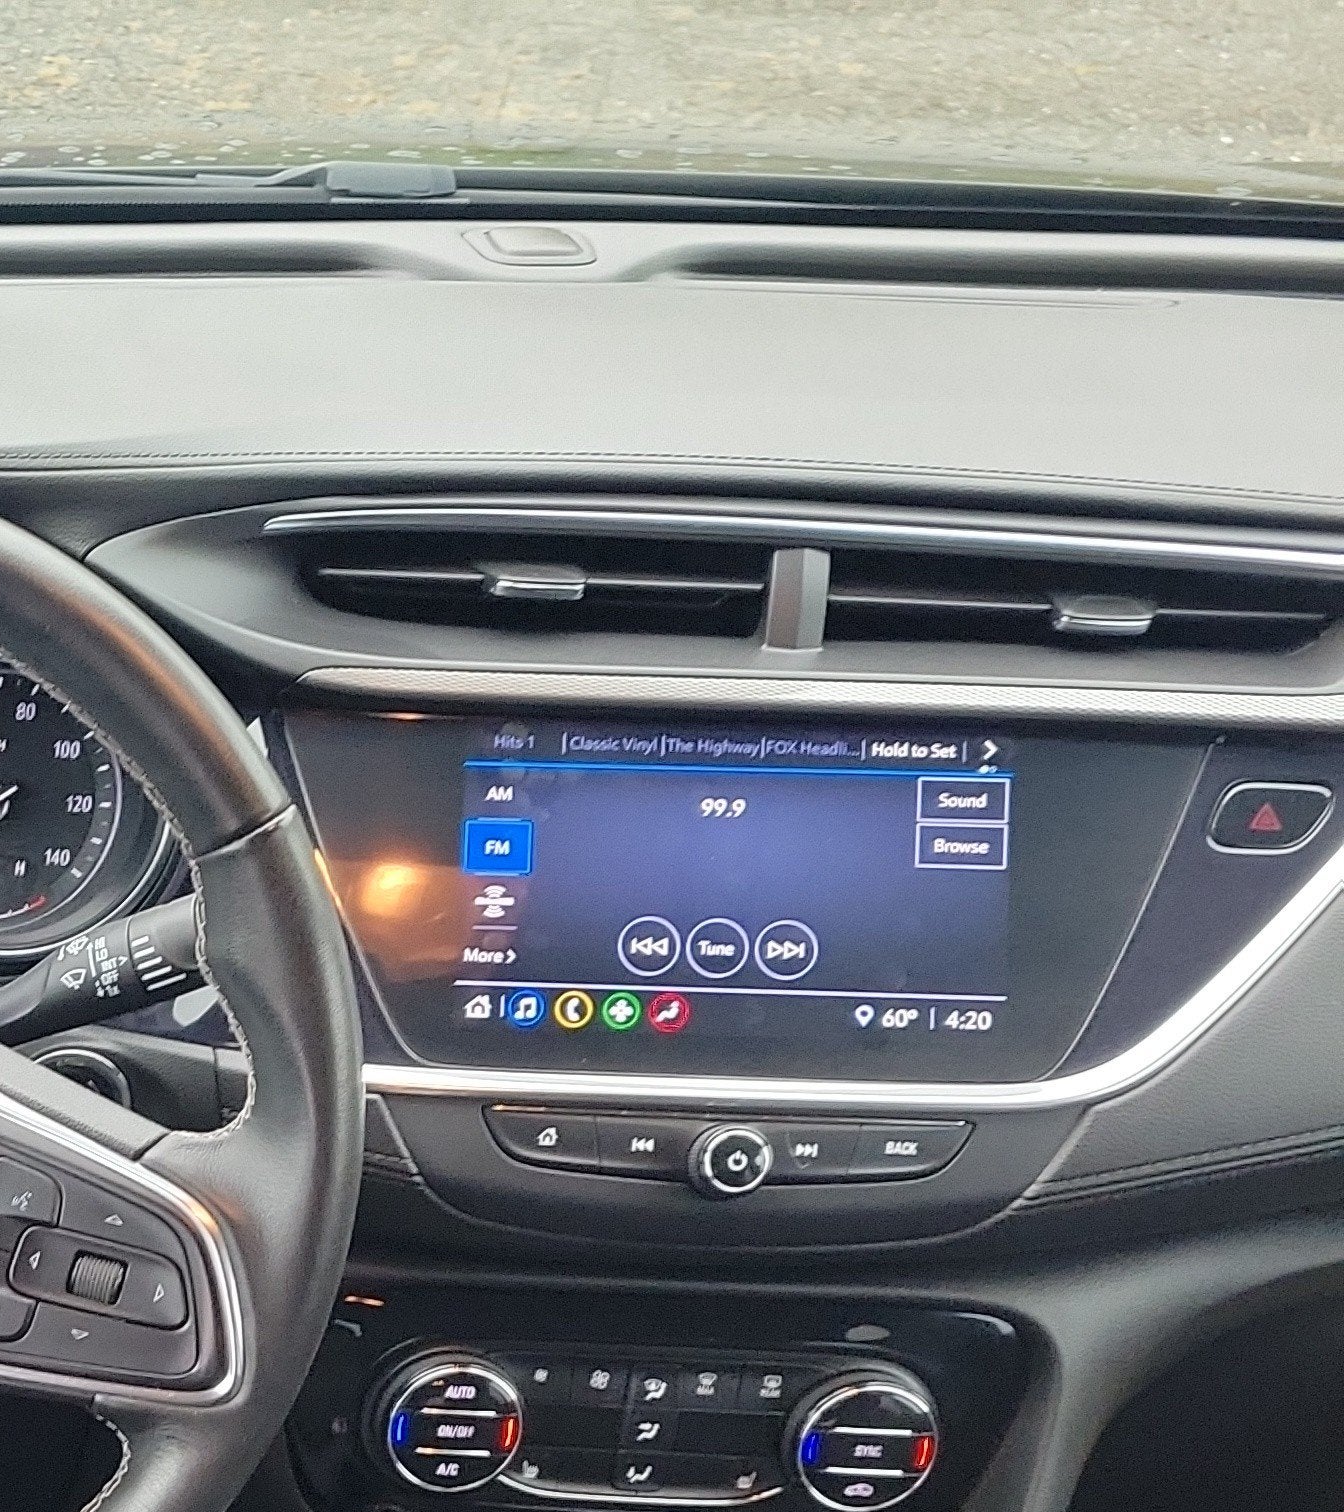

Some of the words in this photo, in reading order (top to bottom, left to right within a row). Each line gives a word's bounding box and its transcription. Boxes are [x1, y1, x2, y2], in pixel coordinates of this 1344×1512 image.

[15, 702, 38, 721] 80
[53, 739, 82, 760] 100
[569, 735, 621, 751] Classic
[622, 736, 659, 756] Vinyl
[666, 737, 695, 753] The
[697, 737, 760, 757] Highway
[765, 739, 798, 755] FOX
[870, 740, 911, 758] Hold
[912, 742, 929, 758] to
[930, 742, 959, 759] Set
[484, 785, 514, 802] AM
[937, 791, 989, 810] Sound
[66, 794, 93, 813] 120
[700, 797, 747, 819] 99.9
[483, 840, 511, 856] FM
[933, 837, 991, 856] Browse
[43, 848, 71, 868] 140
[14, 859, 26, 877] H
[462, 946, 505, 964] More
[697, 939, 736, 957] Tune
[944, 1009, 994, 1031] 4:20
[883, 1140, 920, 1156] BACK
[444, 1384, 478, 1400] AUTO
[436, 1424, 476, 1440] ON/OFF
[435, 1462, 461, 1477] A/C
